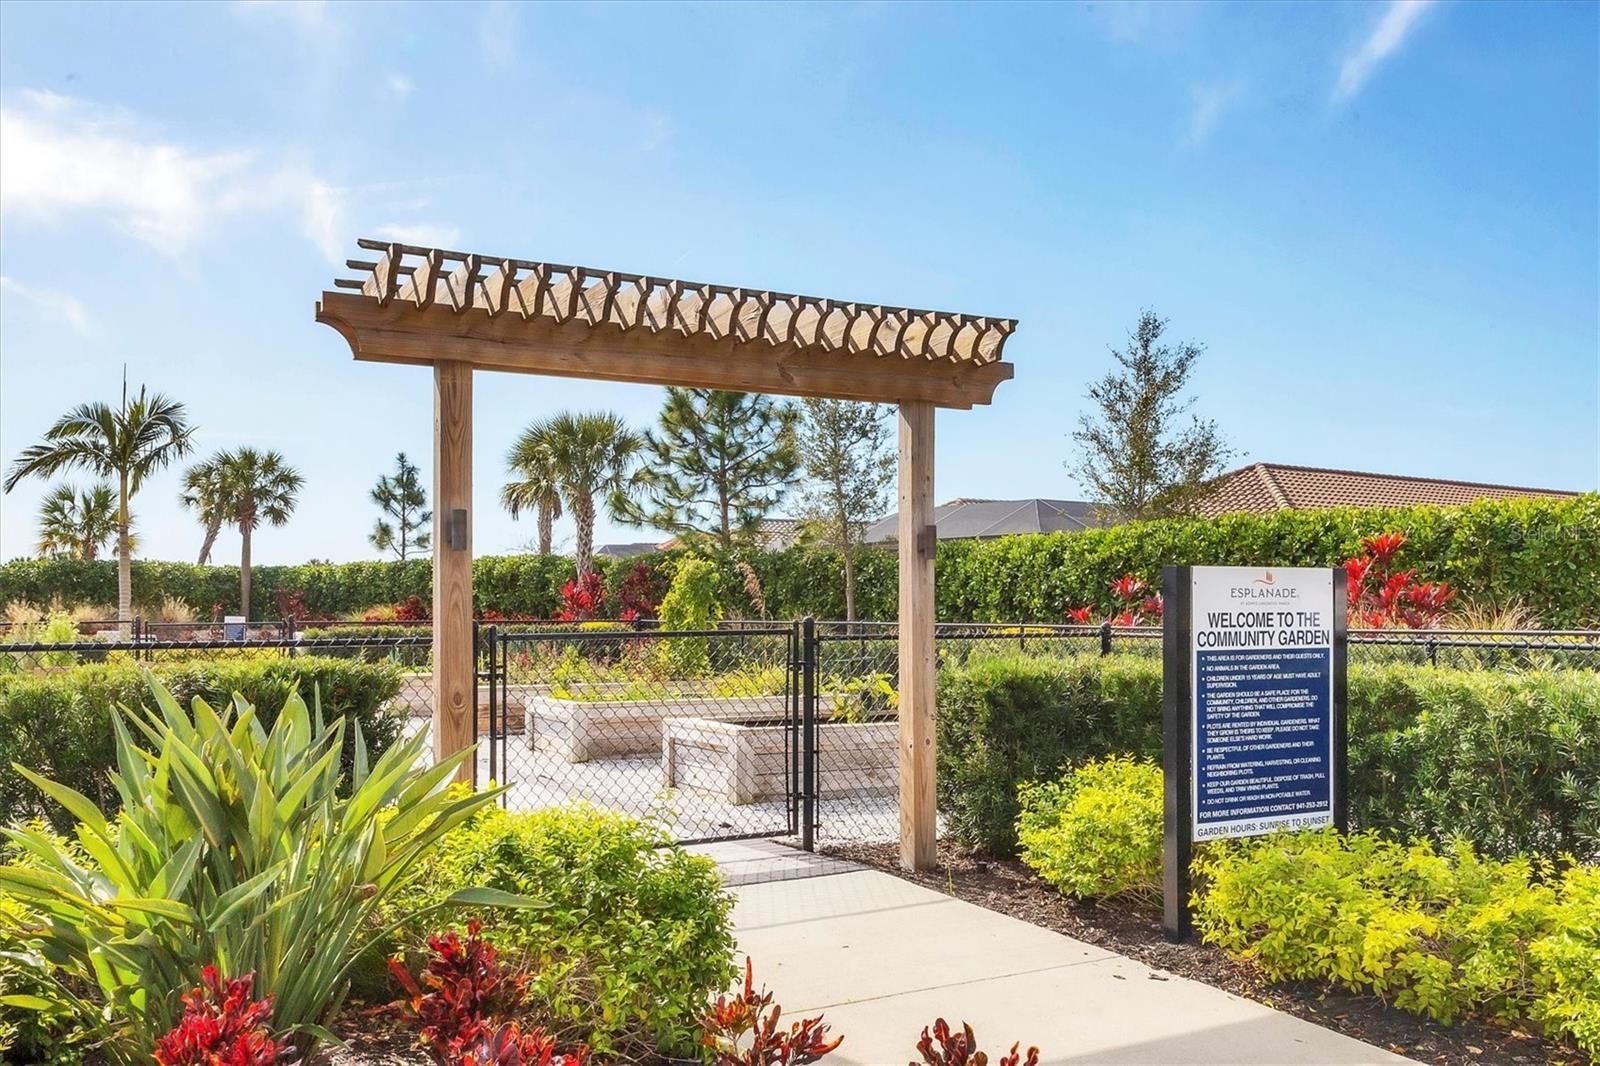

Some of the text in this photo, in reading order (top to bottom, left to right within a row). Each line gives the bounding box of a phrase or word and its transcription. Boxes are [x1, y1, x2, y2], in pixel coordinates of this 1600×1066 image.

[1230, 588, 1297, 598] ESPLANADE
[1207, 612, 1321, 628] WELCOME TO THE
[1197, 630, 1330, 647] COMMUNITY GARDEN
[1200, 811, 1211, 819] FOR
[1212, 810, 1230, 818] MORE
[1230, 806, 1270, 816] INFORMATION
[1270, 803, 1295, 812] CONTACT
[1198, 824, 1229, 836] GARDEN
[1230, 821, 1258, 833] HOURS:
[1292, 817, 1301, 827] TO
[1302, 815, 1330, 826] SUNSET
